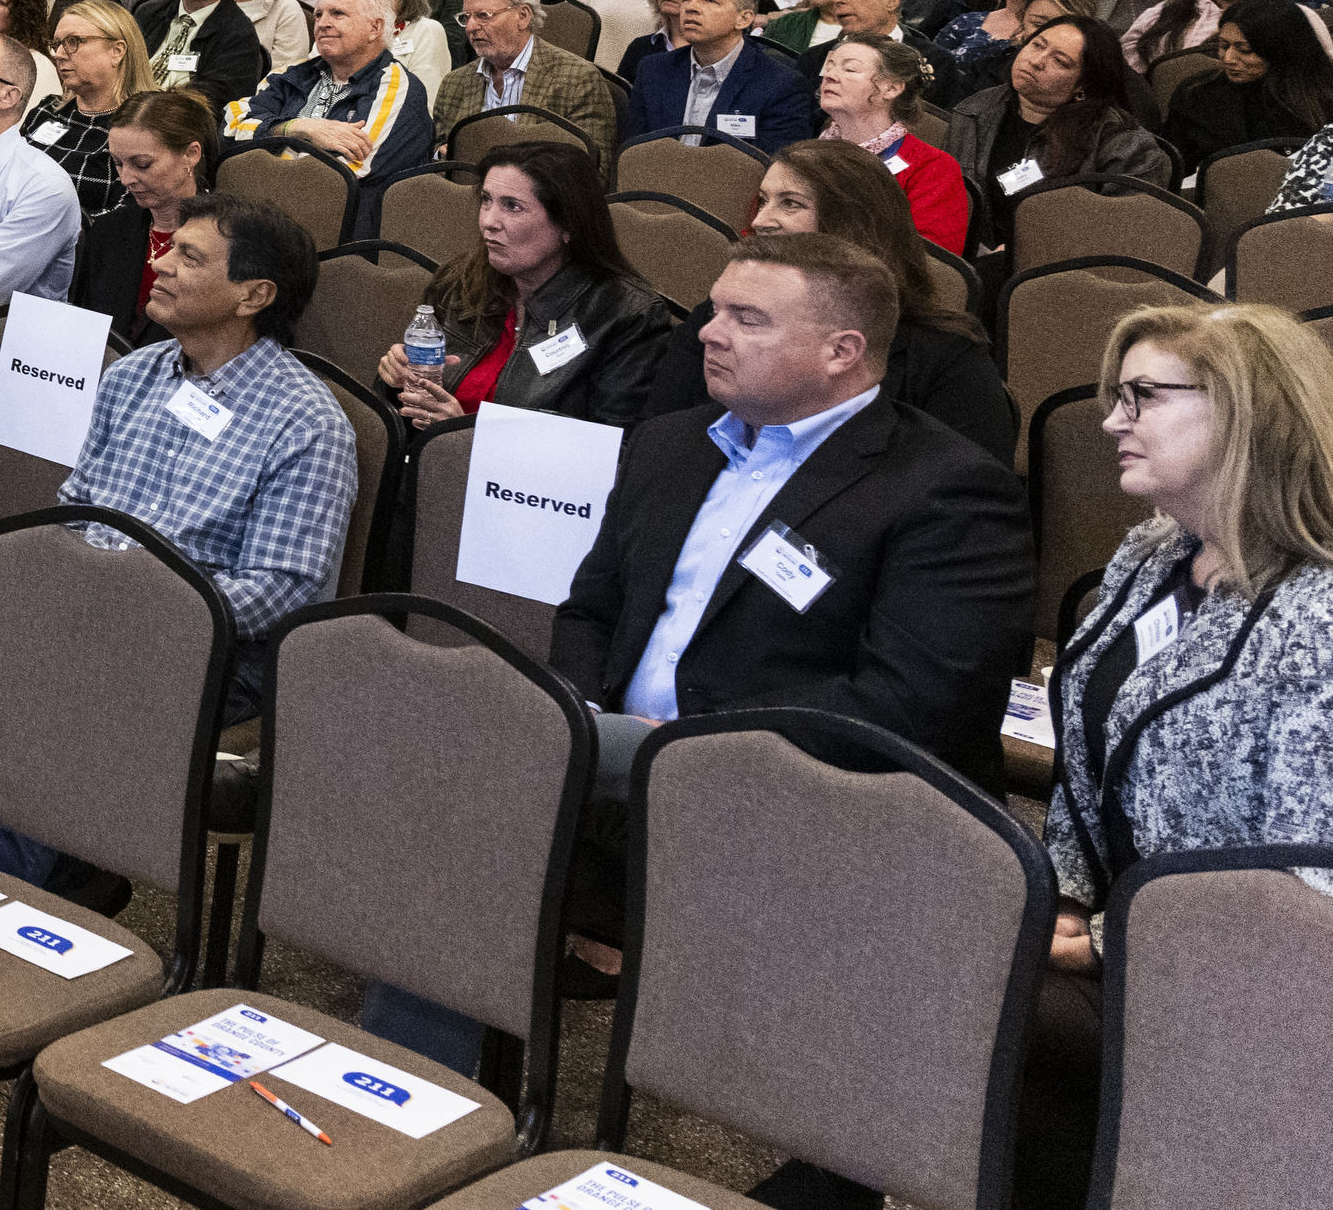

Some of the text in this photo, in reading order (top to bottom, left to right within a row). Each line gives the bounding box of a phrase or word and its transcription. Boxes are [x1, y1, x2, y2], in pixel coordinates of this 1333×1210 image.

[10, 358, 85, 391] Reserved
[187, 401, 212, 421] Richard
[485, 481, 592, 520] Reserved
[776, 561, 796, 580] Cody
[26, 930, 62, 947] 211
[212, 1022, 285, 1057] ORANGE COUNTY
[353, 1076, 396, 1097] 211
[576, 1184, 624, 1209] ORANGE
[585, 1179, 607, 1192] THE
[606, 1190, 643, 1208] PULSE
